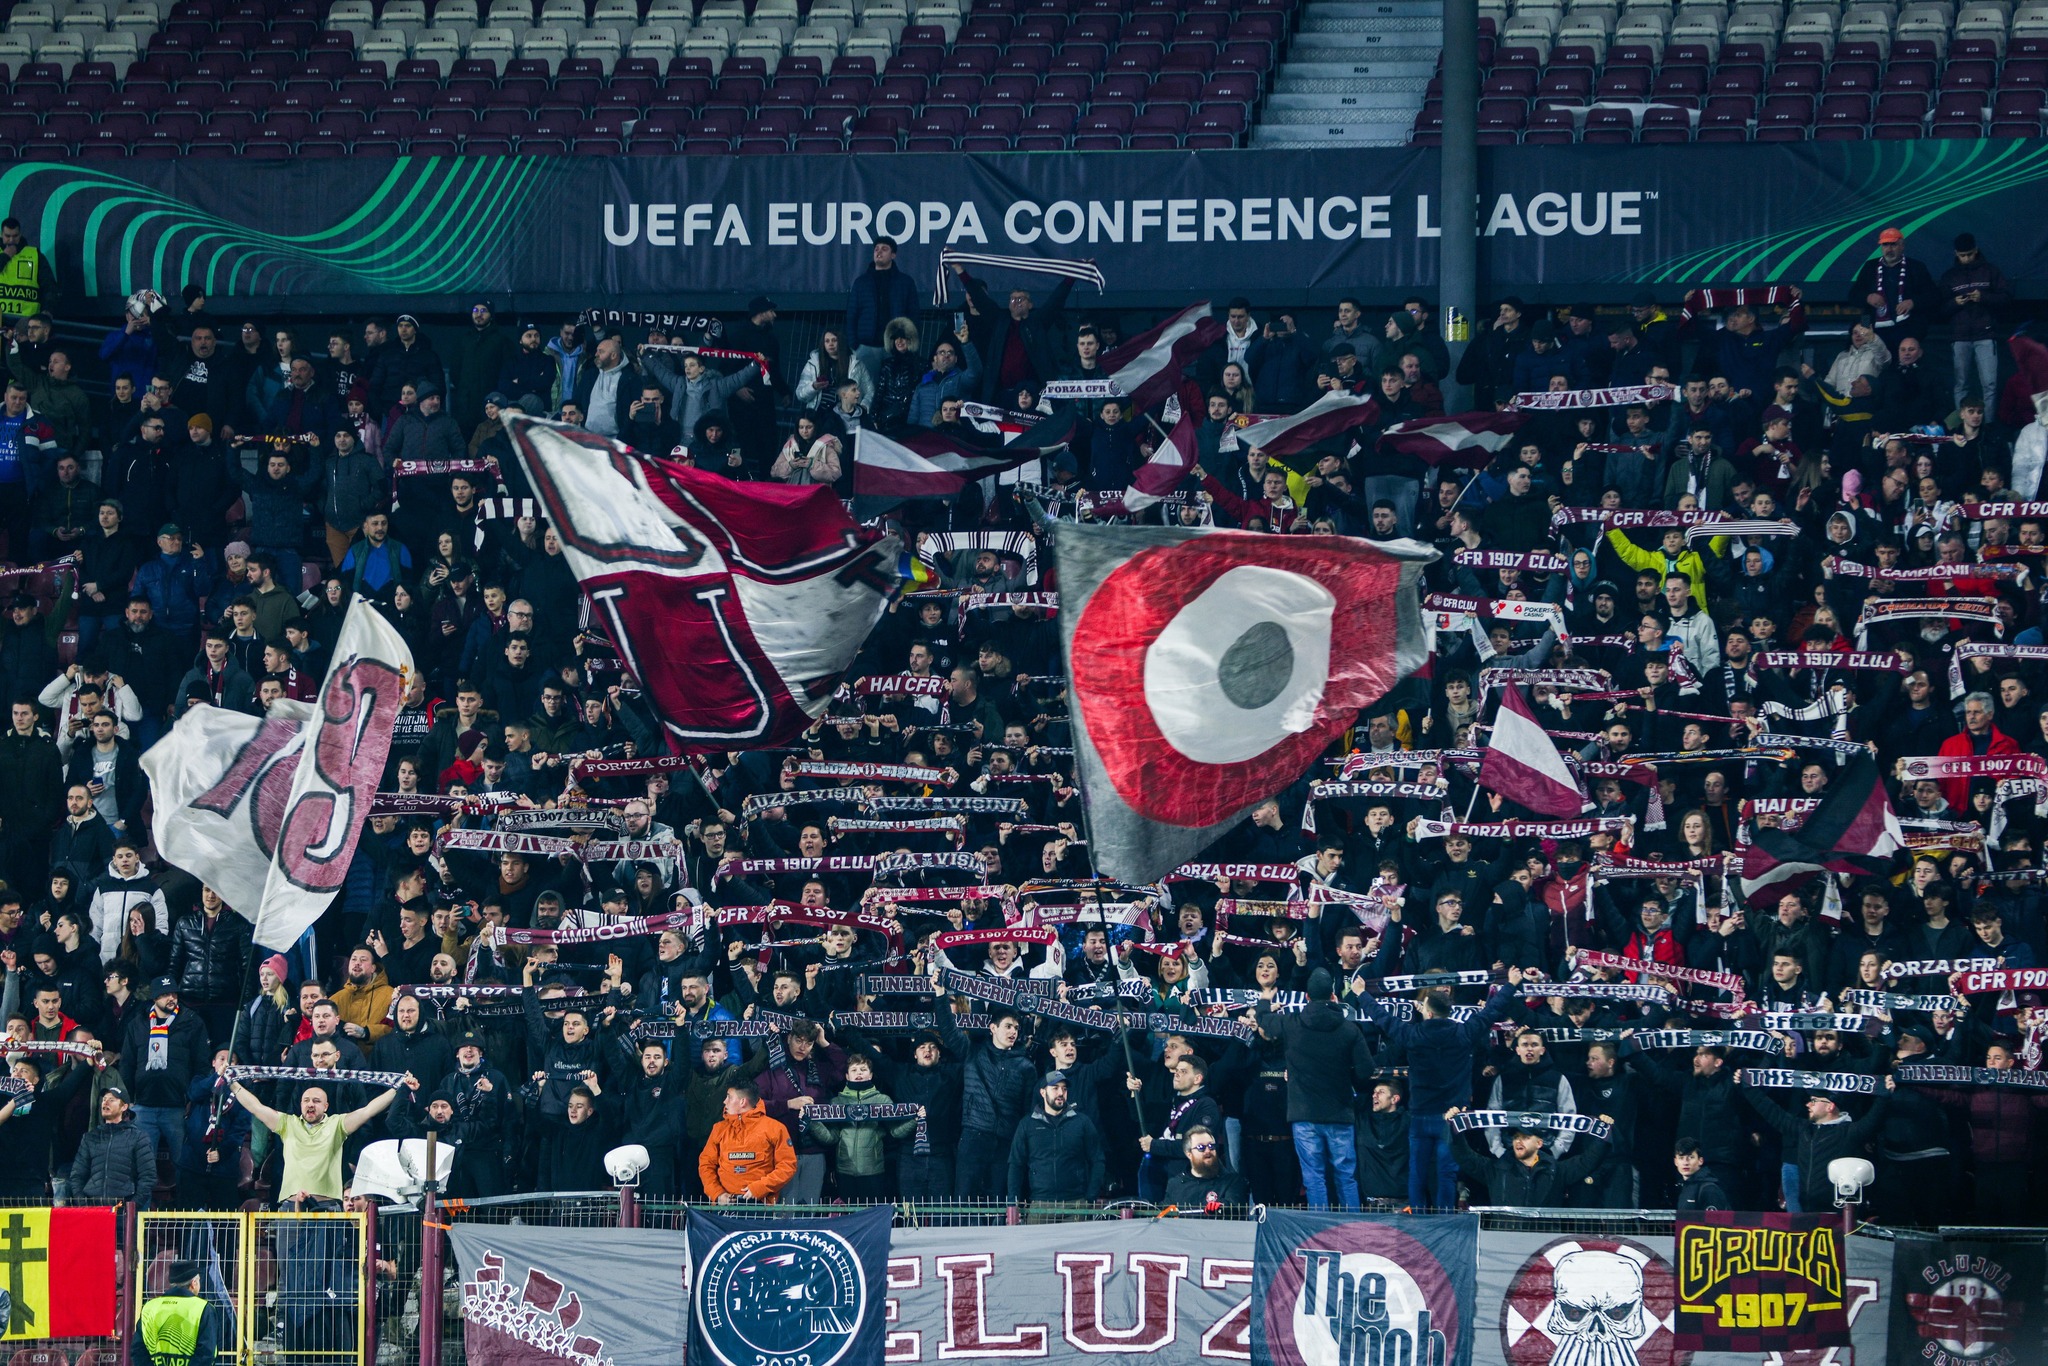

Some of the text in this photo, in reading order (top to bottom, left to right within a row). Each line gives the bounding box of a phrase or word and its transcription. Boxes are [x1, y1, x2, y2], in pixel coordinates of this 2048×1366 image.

[1378, 6, 1393, 14] R08
[1366, 36, 1381, 44] R07
[1354, 66, 1369, 74] R06
[1341, 97, 1357, 105] R05
[1328, 128, 1344, 136] R04
[603, 204, 751, 246] UEFA
[768, 202, 988, 245] EUROPA
[1004, 195, 1392, 244] CONFERENCE
[1417, 192, 1642, 238] LAGUE
[1048, 384, 1107, 394] FORZA CFR
[1979, 502, 2018, 517] CFR
[1614, 511, 1644, 526] CFR
[1454, 551, 1483, 565] CFR
[1488, 552, 1522, 567] 1907
[1443, 597, 1478, 611] CFR CLUJ
[1765, 652, 1893, 668] CFR 1907 CLUJ
[870, 676, 944, 693] HAI CFR!
[585, 760, 655, 774] FORTZA
[1941, 761, 1973, 774] CFR
[1979, 759, 2012, 772] 1907
[1313, 783, 1348, 797] CFR
[1352, 782, 1397, 795] 1907
[1753, 798, 1786, 814] HAI
[535, 812, 564, 824] 1907
[1458, 821, 1592, 838] FORZA CFR CLUJ
[742, 855, 876, 872] CFR 1907 CLUJ
[1225, 864, 1260, 878] CFR
[1263, 863, 1298, 880] CLUJ
[718, 907, 748, 925] CFR
[803, 907, 848, 921] 1907
[943, 929, 1049, 944] CFR 1907 CLUJ
[1967, 970, 2048, 991] CFR 190
[414, 987, 457, 997] CFR
[459, 986, 507, 996] 1907
[950, 971, 1018, 1007] TINERII
[836, 1011, 909, 1028] TINERII
[1633, 1029, 1786, 1056] THE MOB
[554, 1060, 581, 1069] ellesse
[1899, 1064, 1972, 1082] TINERII
[1747, 1068, 1876, 1094] THE MOB
[1449, 1110, 1611, 1139] THE MOB
[719, 1231, 775, 1266] TINERII
[1679, 1224, 1843, 1302] GRUIA
[1922, 1254, 2012, 1292] CLUJUL
[1296, 1248, 1388, 1323] The
[1949, 1285, 1987, 1298] 1907
[34, 1354, 48, 1363] 50
[102, 1354, 116, 1363] 49
